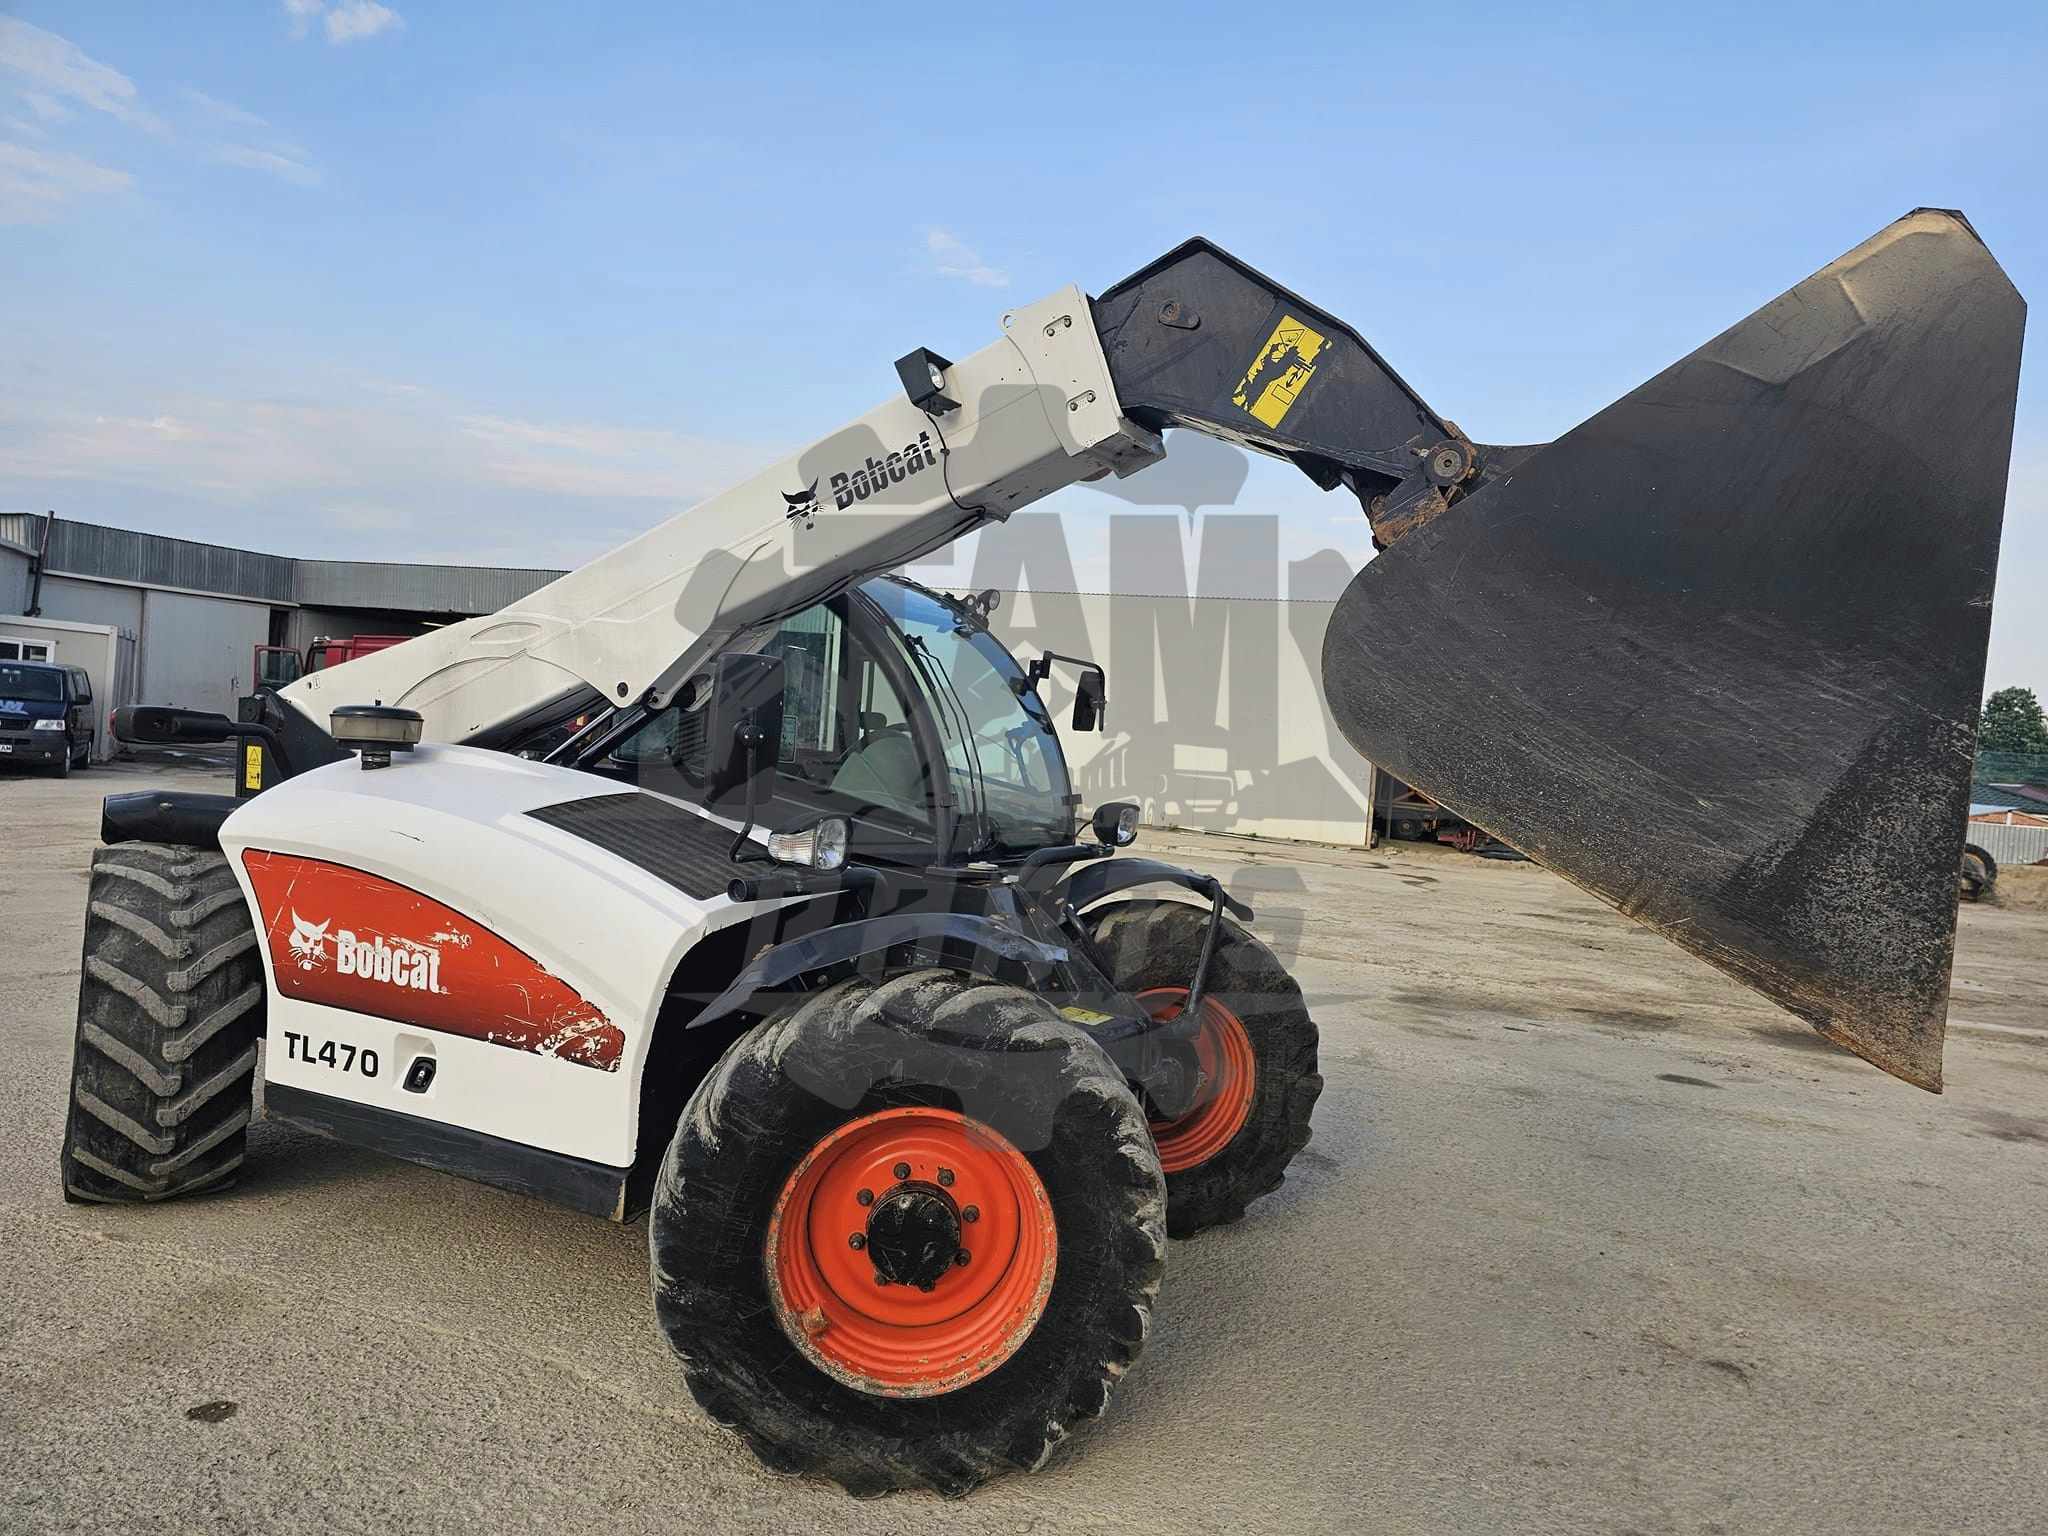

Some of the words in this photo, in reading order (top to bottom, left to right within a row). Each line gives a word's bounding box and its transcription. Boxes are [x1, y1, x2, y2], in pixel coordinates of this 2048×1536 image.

[829, 431, 936, 511] Bobcat
[337, 929, 441, 993] Bobcat
[284, 1031, 379, 1078] TL470
